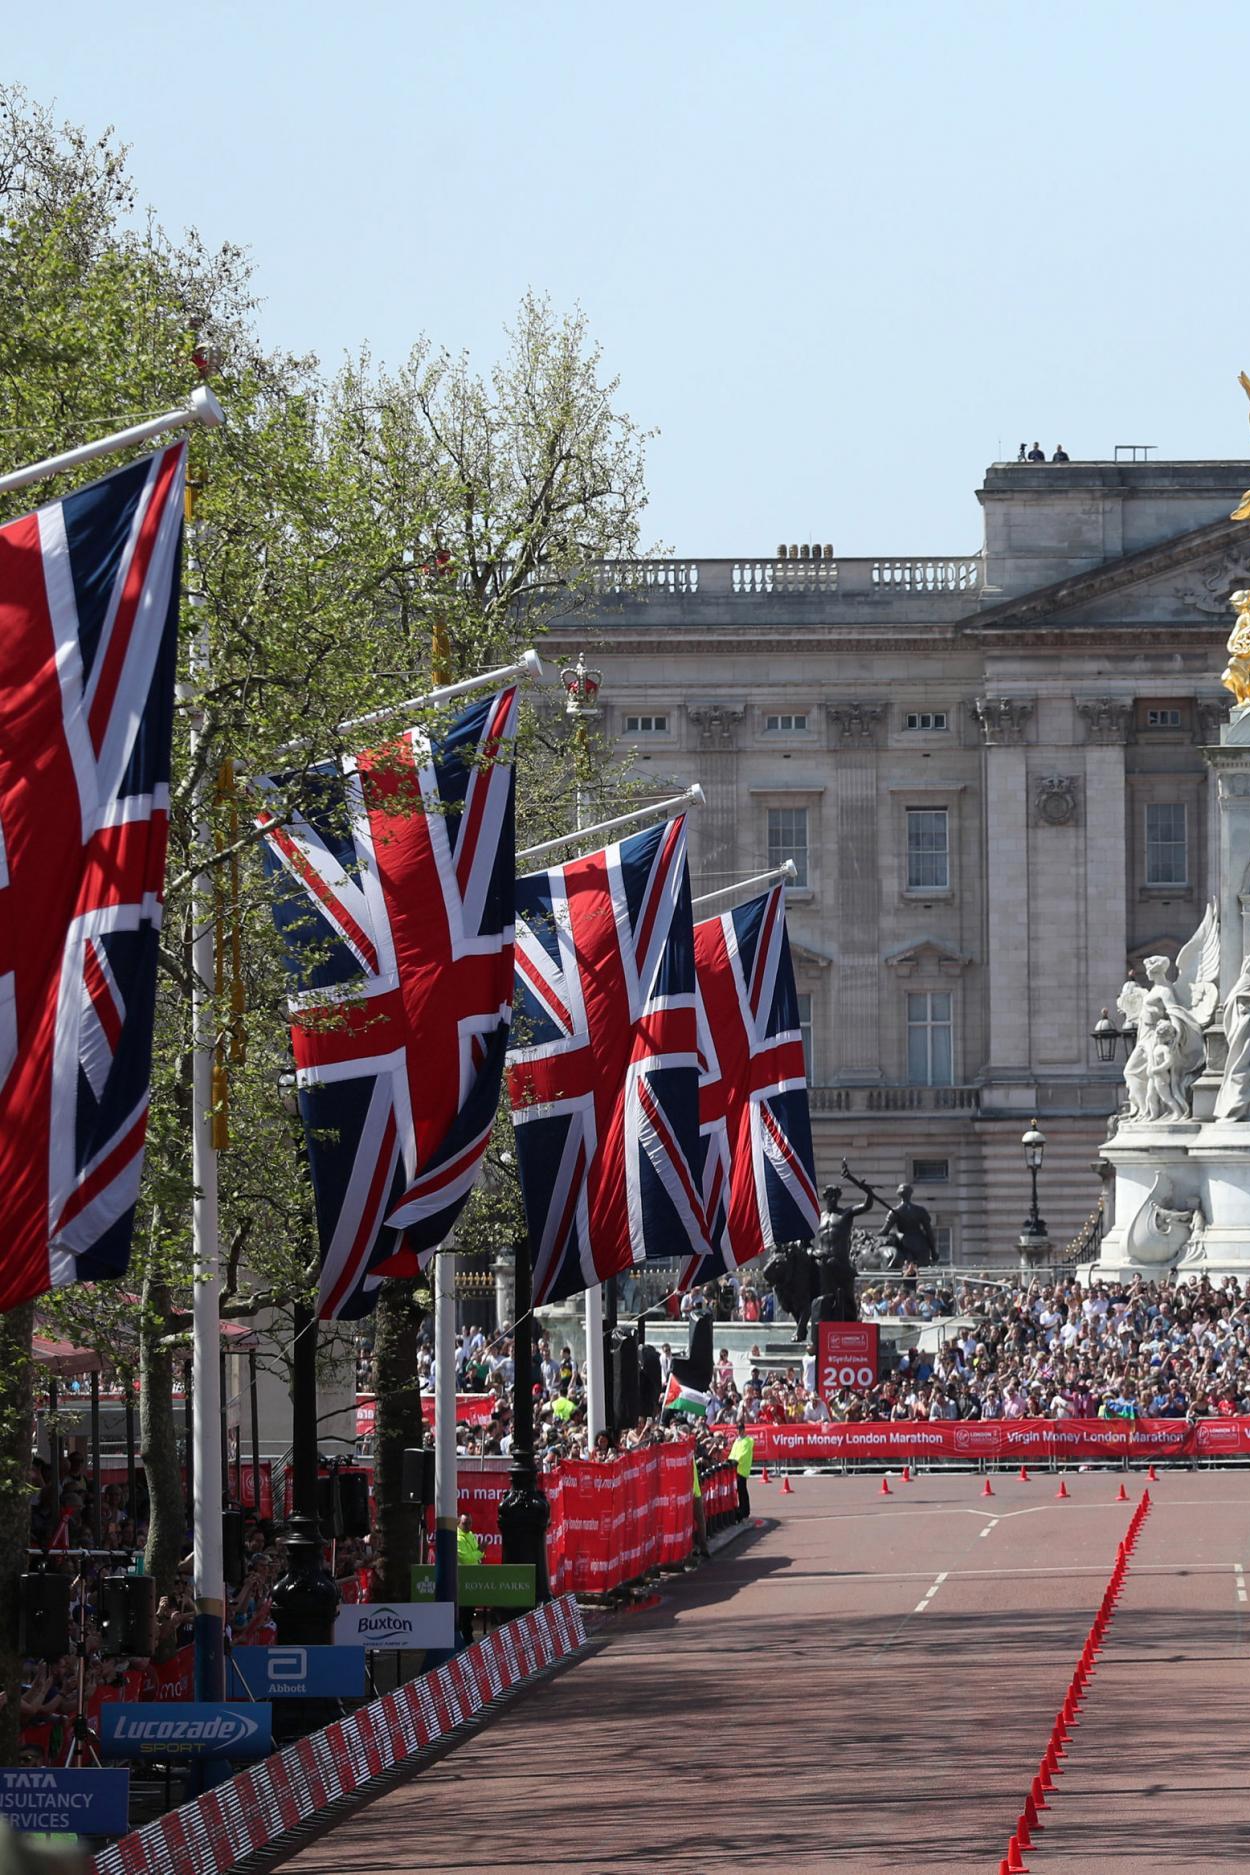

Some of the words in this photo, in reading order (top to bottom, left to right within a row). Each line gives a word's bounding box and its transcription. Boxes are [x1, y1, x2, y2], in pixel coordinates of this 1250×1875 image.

[823, 1367, 873, 1386] 200
[772, 1433, 805, 1447] Virgin
[807, 1433, 843, 1447] Money
[846, 1432, 887, 1444] London
[889, 1431, 943, 1444] Marathon
[1006, 1431, 1039, 1444] Virgin
[1043, 1431, 1080, 1444] Money
[1083, 1431, 1126, 1442] London
[1129, 1432, 1184, 1443] Marathon
[465, 1582, 497, 1591] ROYAL
[500, 1582, 530, 1591] PARKS
[358, 1617, 413, 1633] Buxton
[269, 1683, 306, 1693] Abbott
[113, 1716, 233, 1739] Lucozade
[140, 1743, 206, 1753] SPORT
[4, 1773, 57, 1788] TATA
